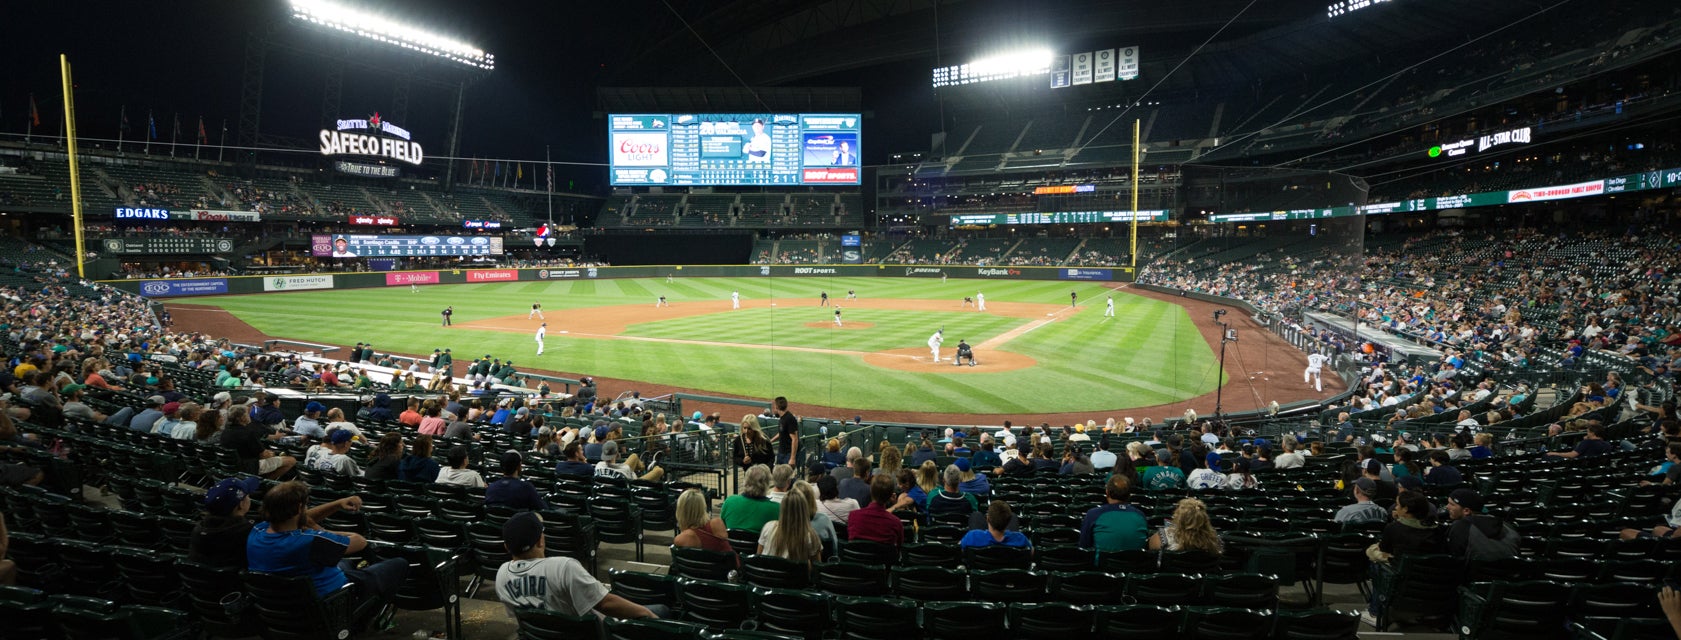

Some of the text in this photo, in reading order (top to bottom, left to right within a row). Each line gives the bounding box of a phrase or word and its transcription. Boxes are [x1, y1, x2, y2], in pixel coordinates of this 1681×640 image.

[1511, 127, 1531, 143] CLUB
[320, 129, 423, 165] SAFECO FIELD
[620, 139, 660, 153] Coors
[348, 162, 396, 176] TRUE TO THE BLUE
[197, 211, 254, 222] Coors LIGHT
[1150, 470, 1182, 485] HERNAND
